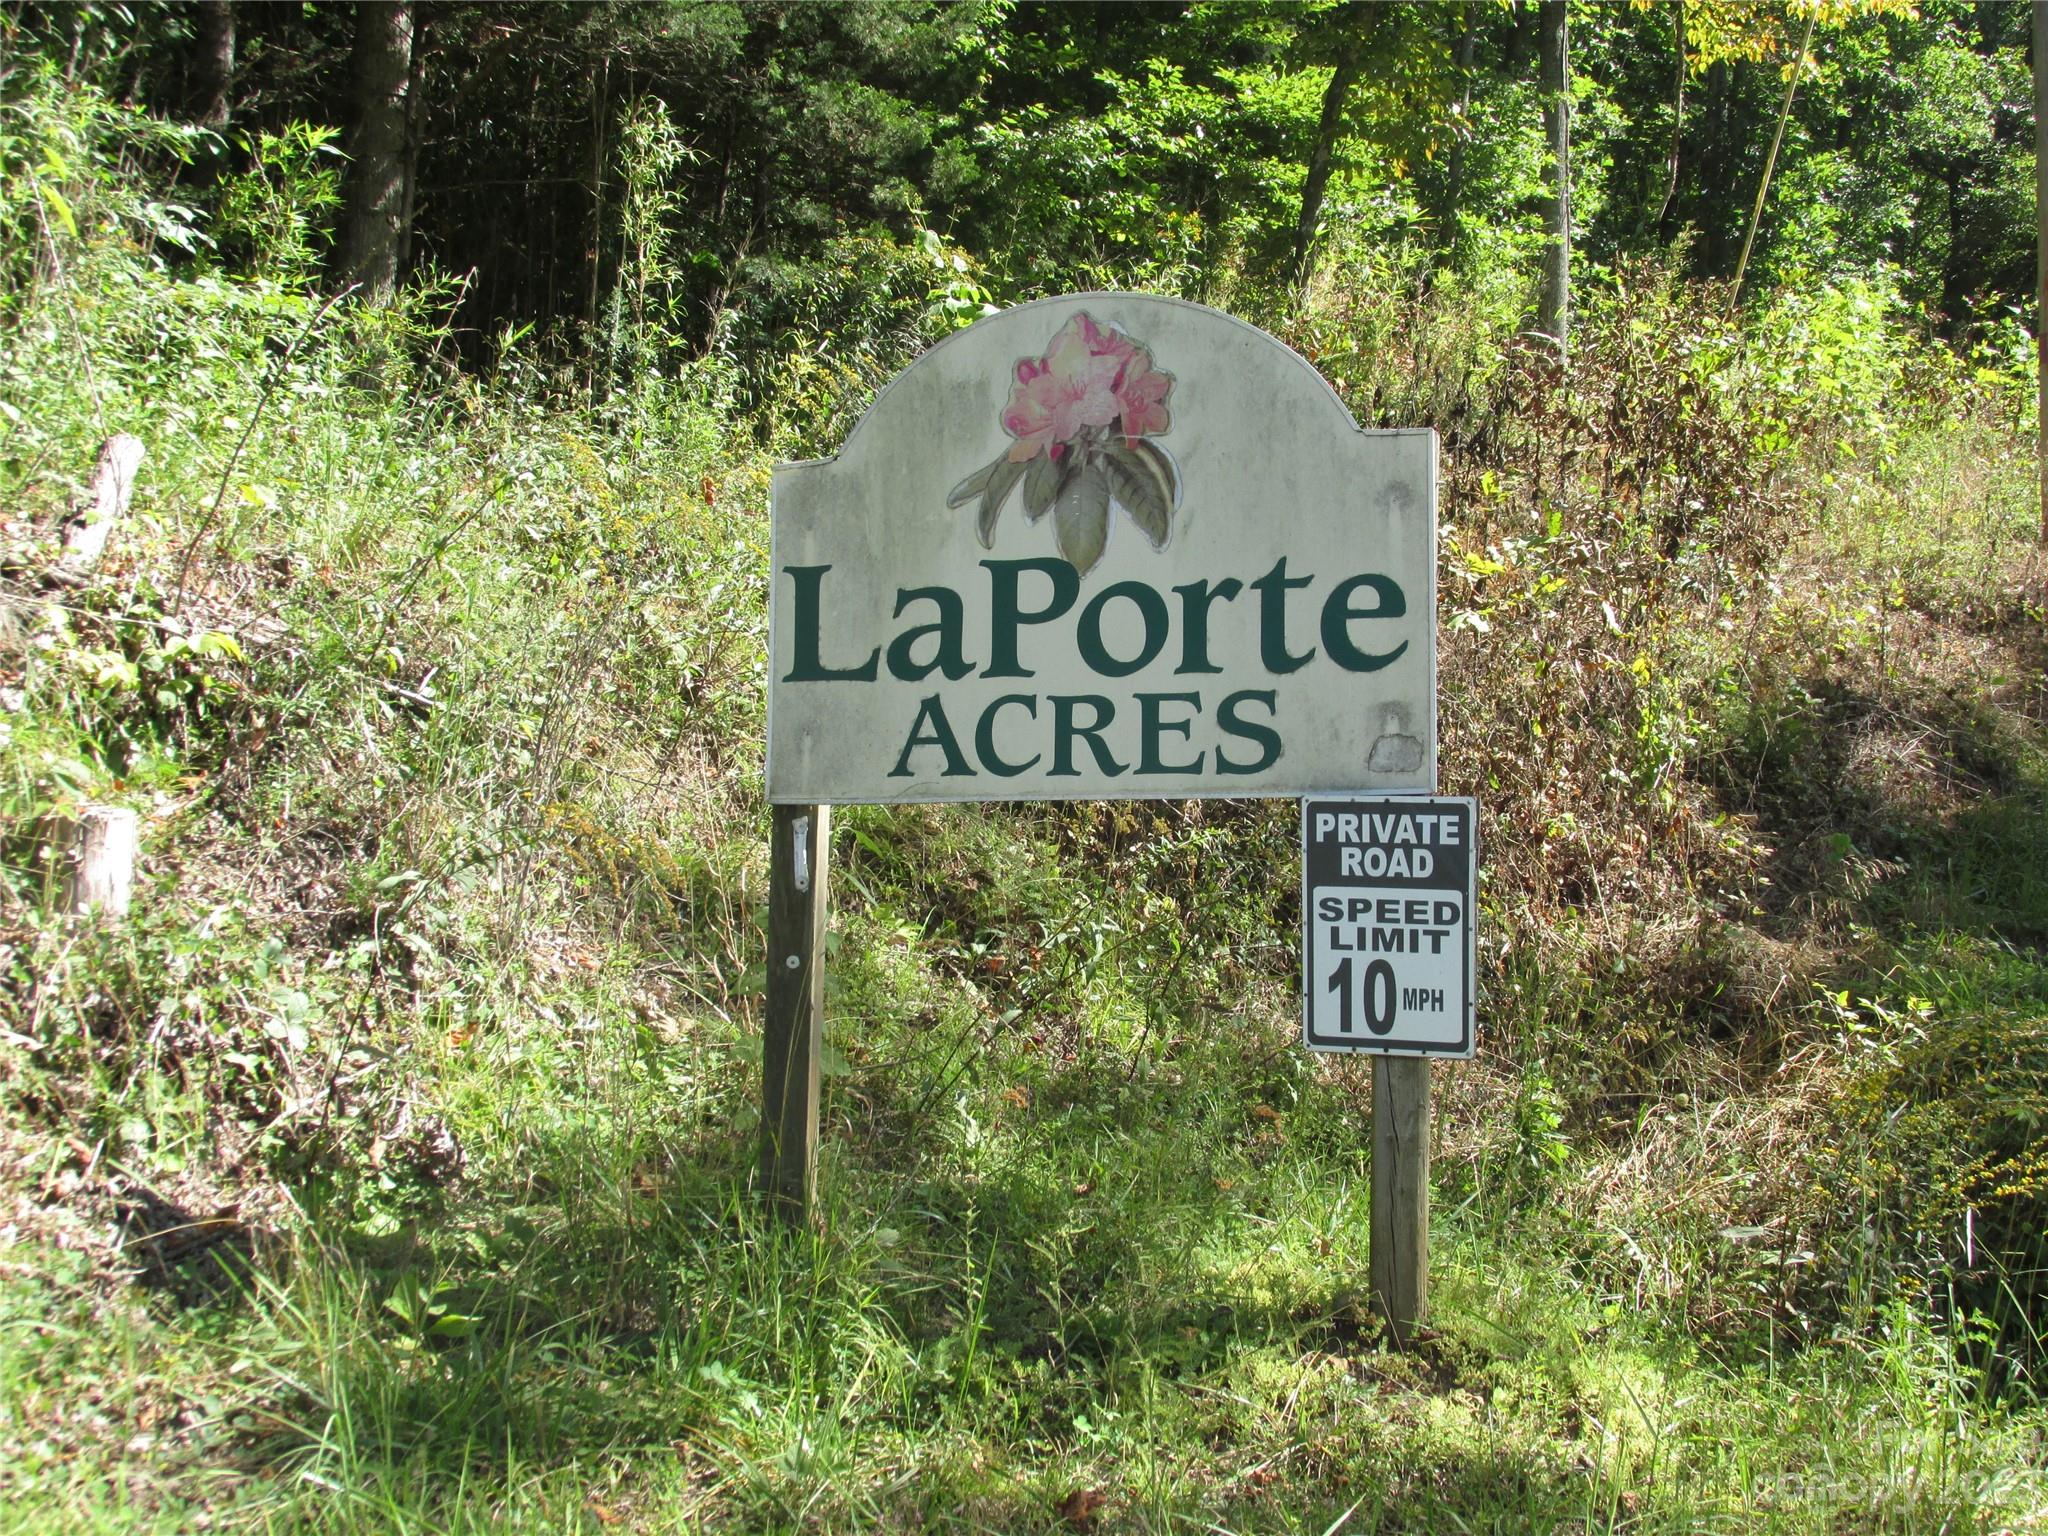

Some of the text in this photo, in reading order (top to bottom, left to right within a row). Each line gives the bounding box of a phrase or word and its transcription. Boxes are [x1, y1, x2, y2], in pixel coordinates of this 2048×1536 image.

[782, 555, 1409, 683] LaPorte
[886, 689, 1284, 778] ACRES
[1315, 812, 1460, 845] PRIVATE
[1340, 847, 1434, 878] ROAD
[1318, 897, 1461, 926] SPEED
[1330, 926, 1450, 955] LIMIT
[1328, 957, 1444, 1036] 10 MPH
